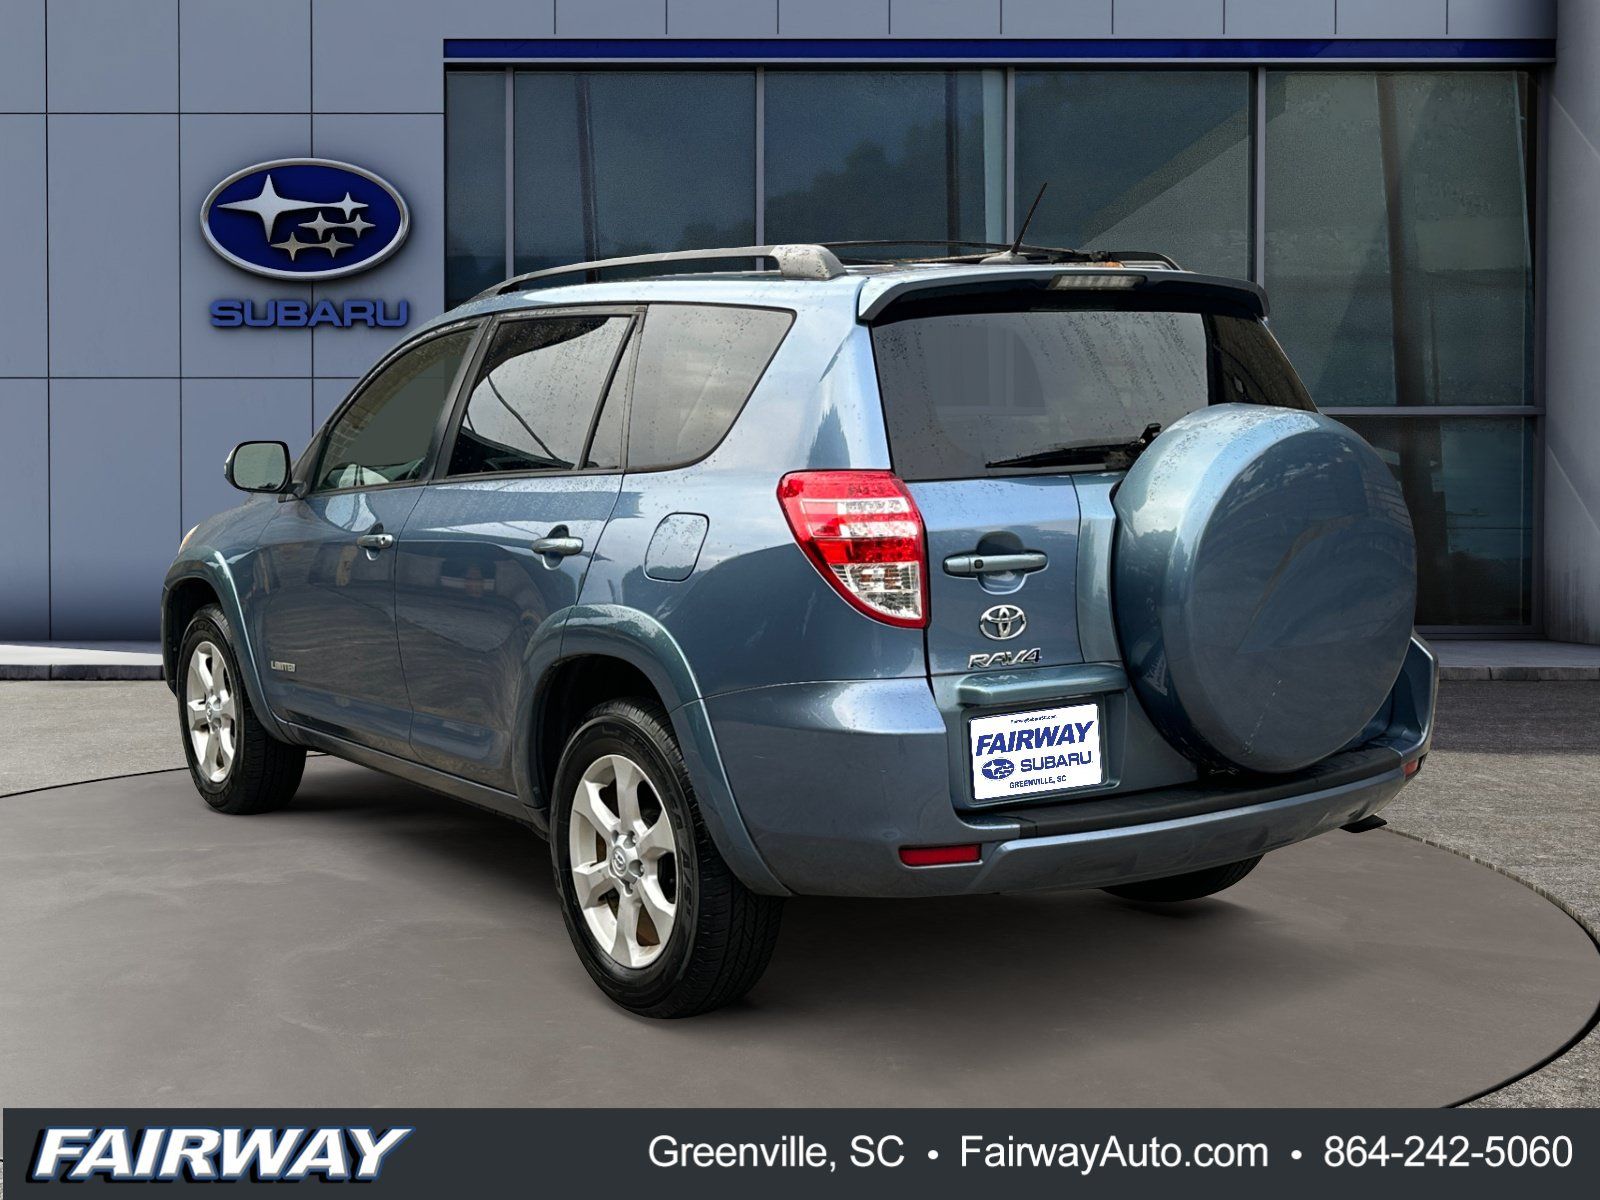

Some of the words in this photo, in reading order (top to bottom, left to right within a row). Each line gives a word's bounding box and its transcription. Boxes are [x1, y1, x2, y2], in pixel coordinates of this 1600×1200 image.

[209, 299, 409, 328] SUBARU
[967, 647, 1043, 670] RAV4
[975, 720, 1095, 757] FAIRWAY
[1020, 750, 1093, 773] SUBARU
[1009, 776, 1056, 789] GREENVILLE,
[1056, 774, 1067, 783] SC
